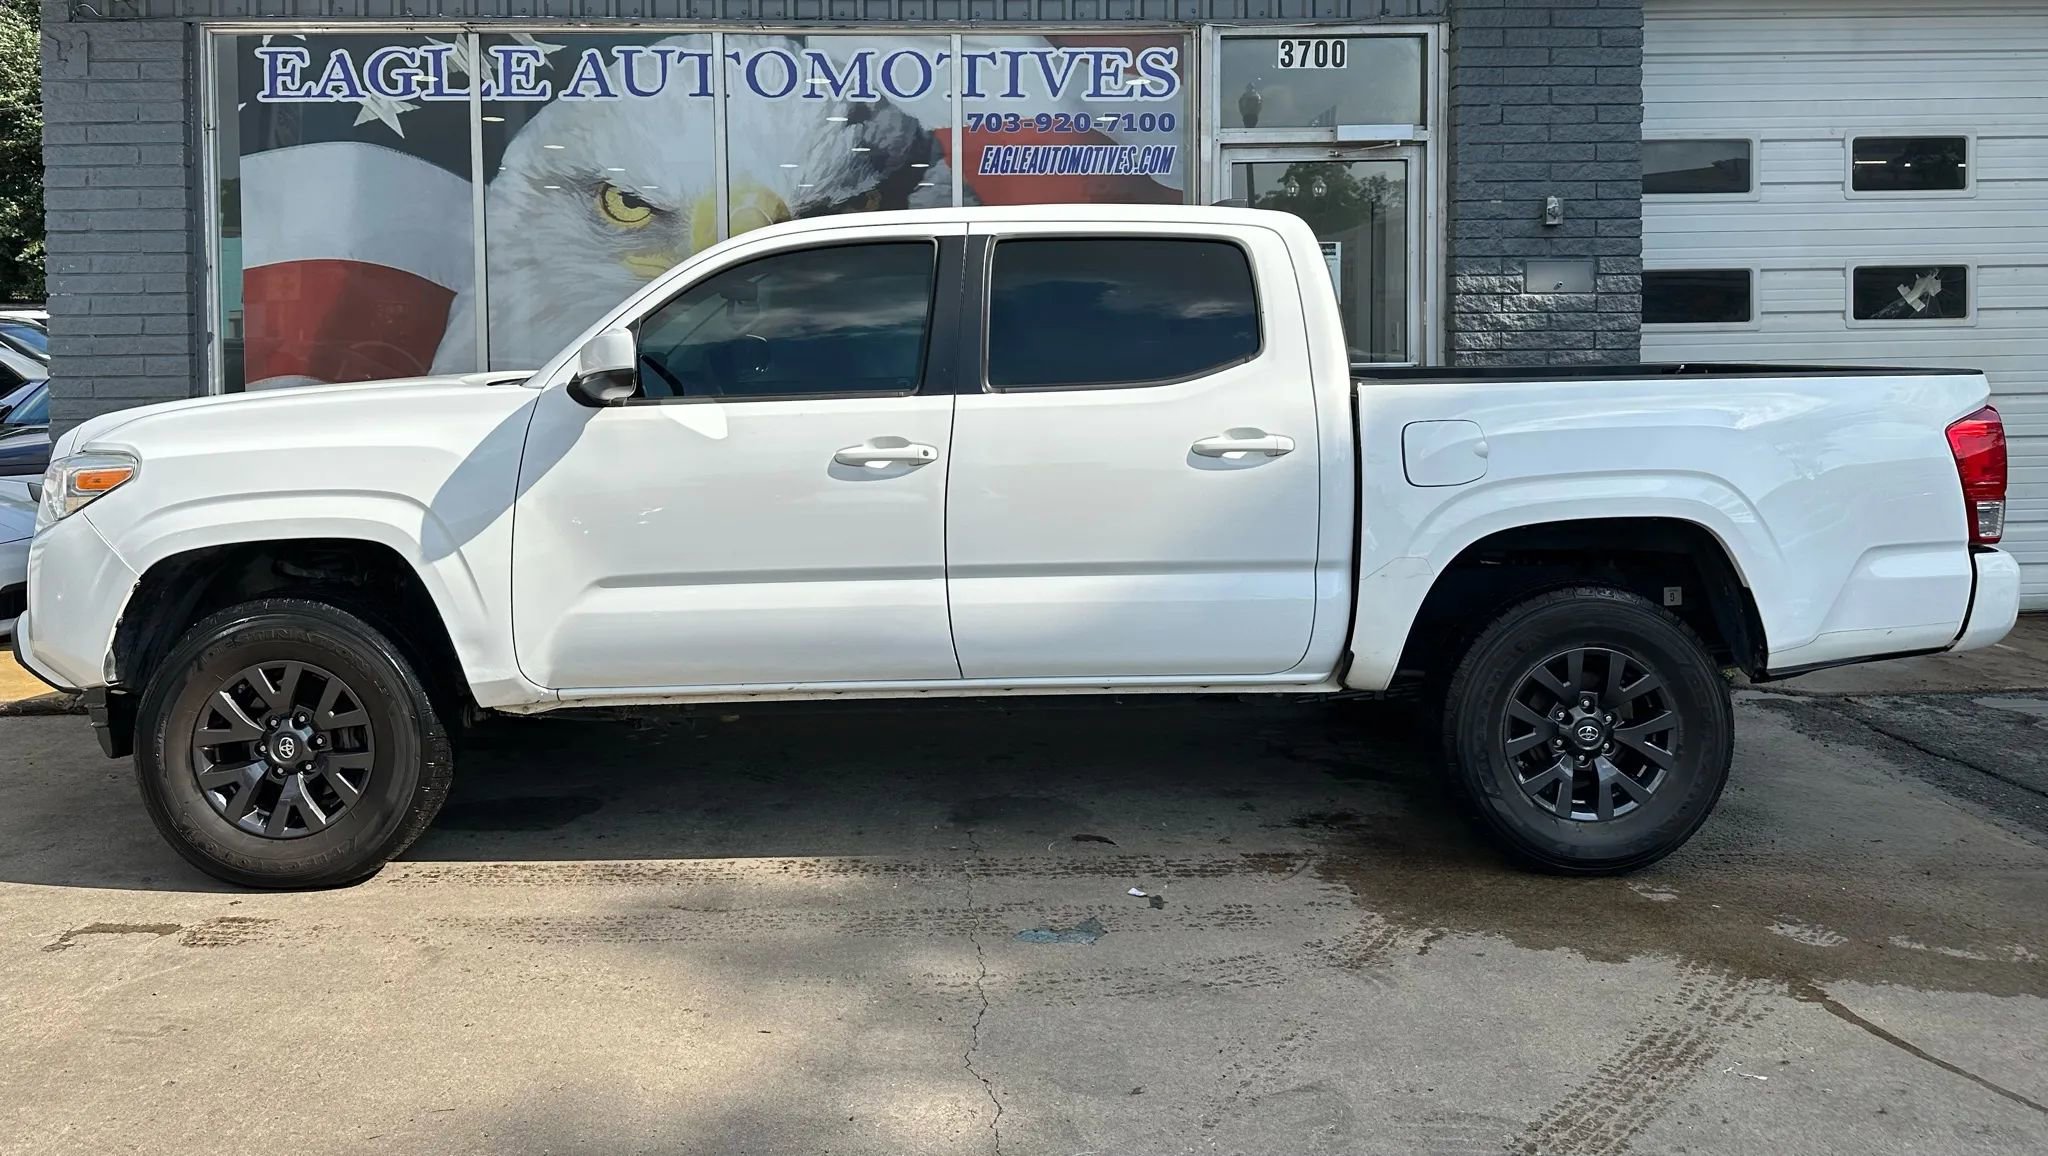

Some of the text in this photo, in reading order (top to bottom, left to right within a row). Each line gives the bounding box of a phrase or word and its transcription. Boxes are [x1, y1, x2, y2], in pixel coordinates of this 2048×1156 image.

[1280, 39, 1346, 68] 3700
[255, 46, 1180, 102] EAGLE AUTOMOTIVES
[967, 112, 1176, 133] 703-920-7100
[978, 145, 1177, 176] EAGLEAUTOMOTIVES.COM
